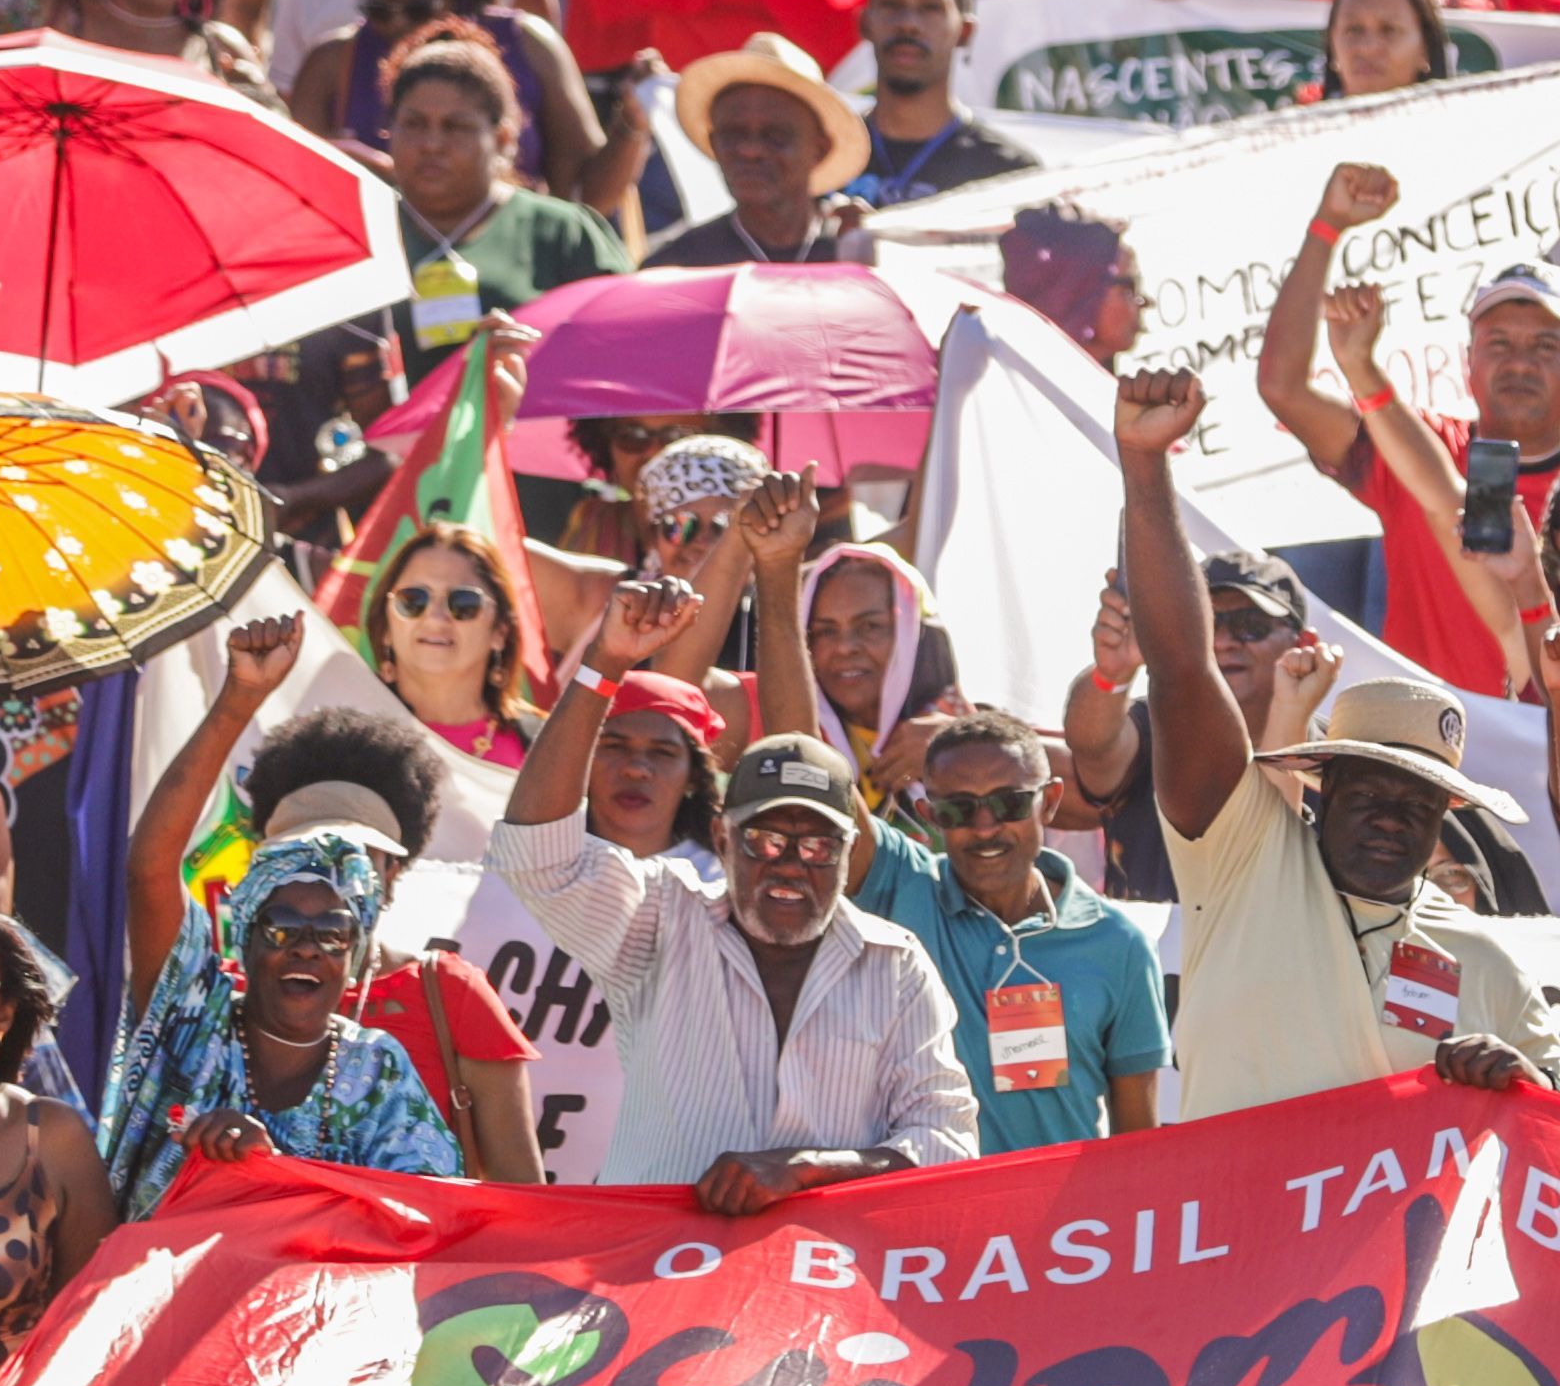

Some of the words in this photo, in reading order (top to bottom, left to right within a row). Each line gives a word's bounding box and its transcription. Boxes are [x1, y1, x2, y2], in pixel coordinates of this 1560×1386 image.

[1017, 47, 1296, 112] NASCENTES
[653, 1242, 723, 1279] O
[789, 1199, 1231, 1303] BRASIL
